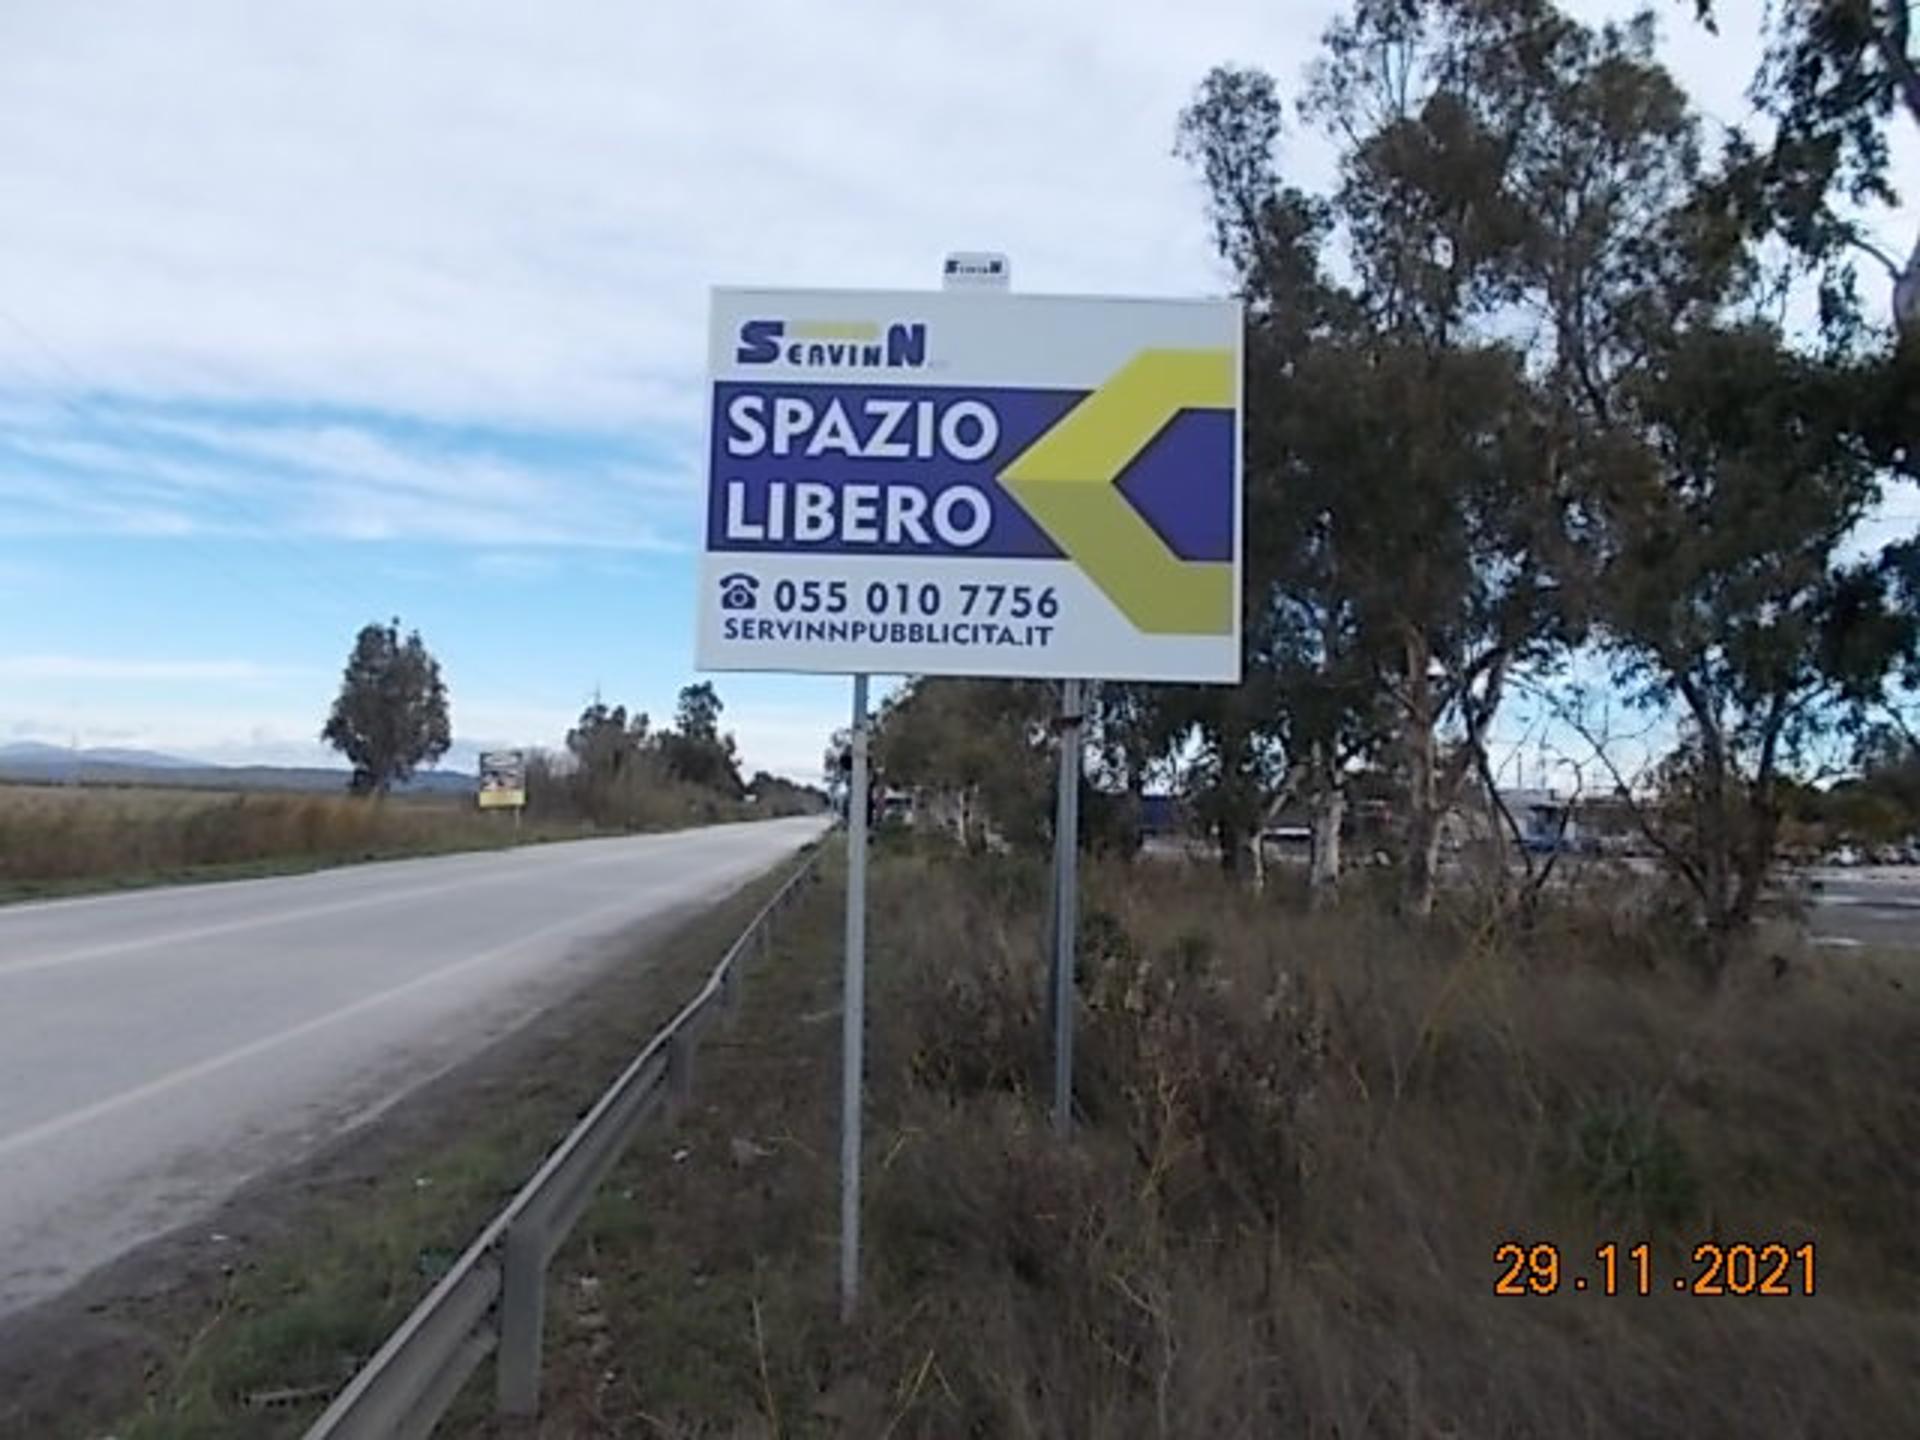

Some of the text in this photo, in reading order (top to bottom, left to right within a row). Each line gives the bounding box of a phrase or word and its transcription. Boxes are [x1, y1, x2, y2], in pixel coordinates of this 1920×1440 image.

[728, 395, 998, 460] SPAZIO
[727, 482, 991, 547] LIBERO
[773, 579, 1058, 619] 055 010 7756
[723, 617, 1054, 646] SERVINNPUBBLICITA.IT
